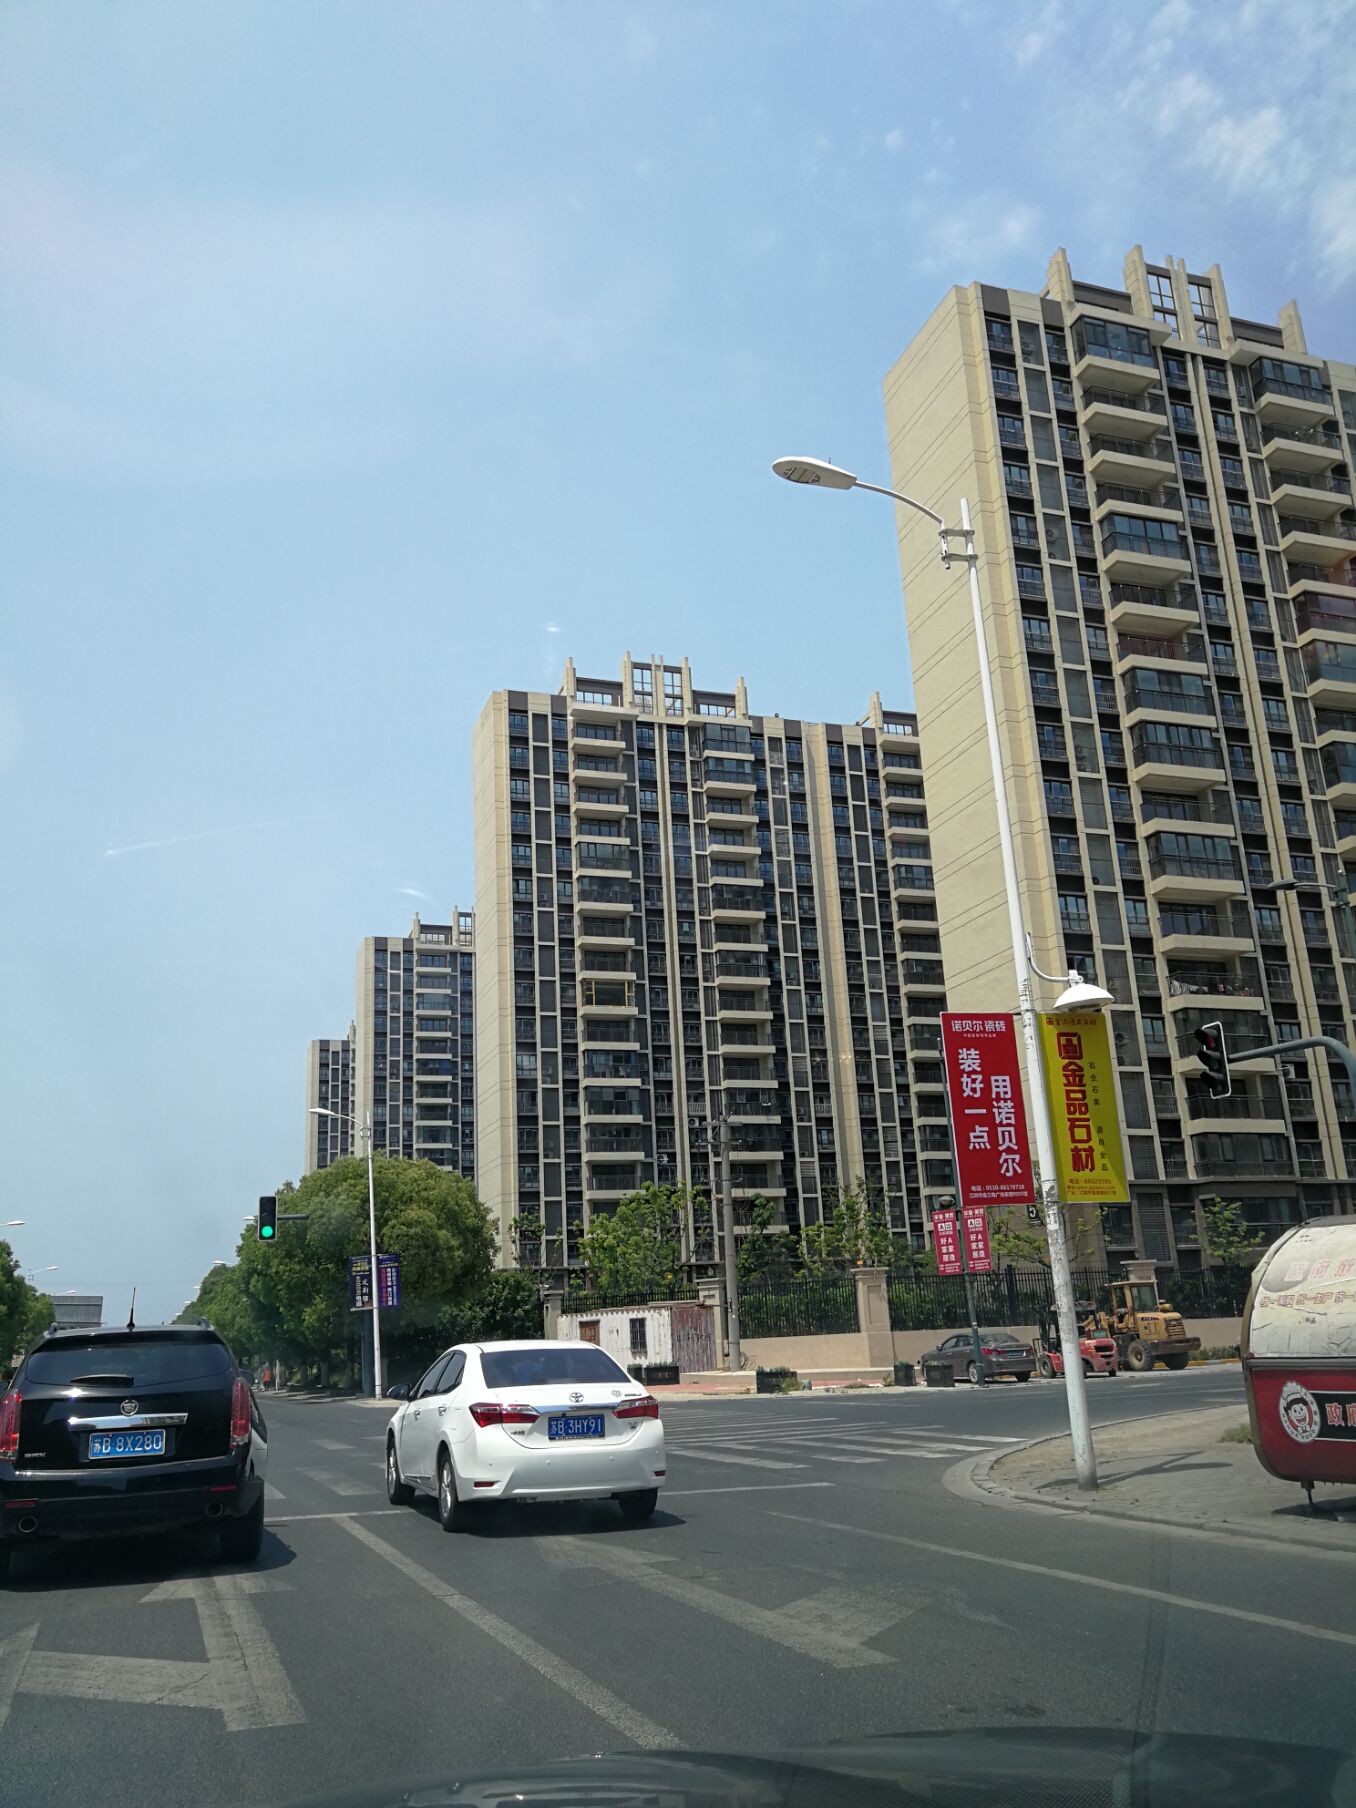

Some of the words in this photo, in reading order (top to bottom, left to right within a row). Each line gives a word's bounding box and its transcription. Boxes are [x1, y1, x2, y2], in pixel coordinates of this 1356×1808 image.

[951, 1020, 984, 1032] 诺贝尔
[984, 1020, 1006, 1032] 瓷砖
[958, 1047, 991, 1150] 装好一点
[990, 1075, 1022, 1177] 用诺贝尔
